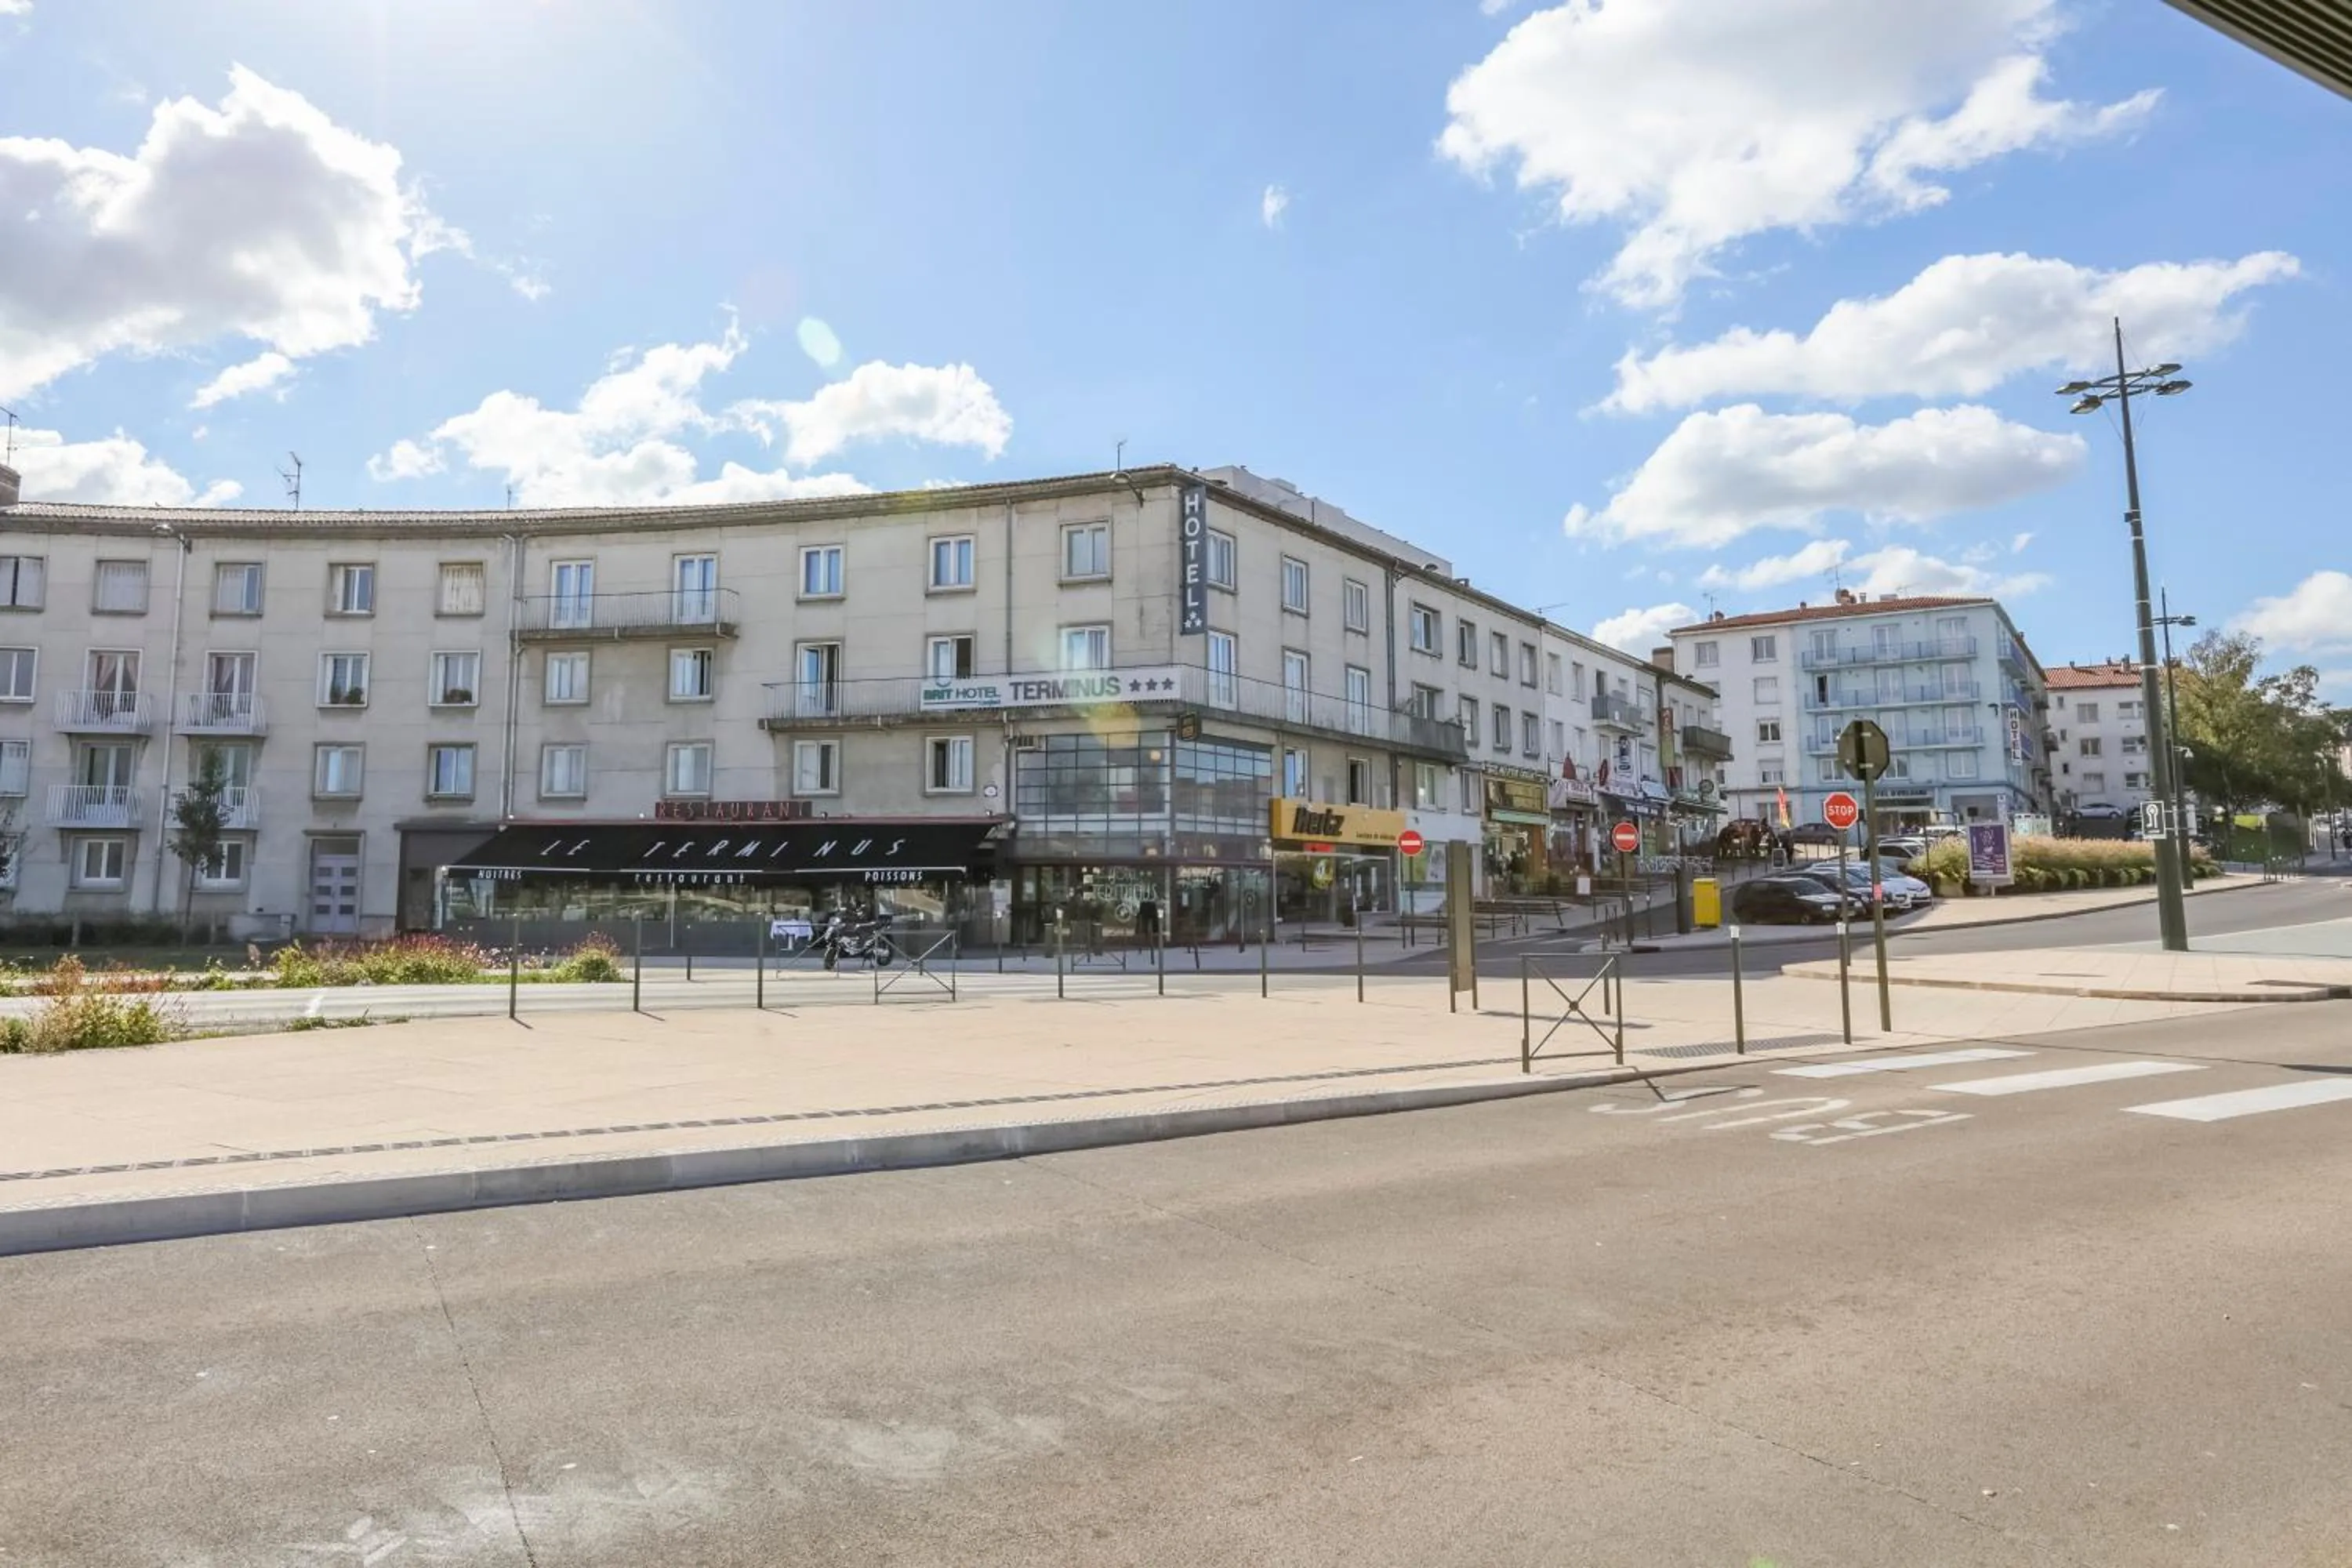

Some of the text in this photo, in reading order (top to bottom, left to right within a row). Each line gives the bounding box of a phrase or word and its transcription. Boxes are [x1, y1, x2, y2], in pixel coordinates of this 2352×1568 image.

[1185, 493, 1200, 607] HOTEL
[924, 686, 1001, 699] BRIT HOTEL
[1009, 677, 1120, 701] TERMINUS
[2009, 710, 2020, 760] HOTEL
[659, 802, 803, 817] RESTAURANT
[1828, 804, 1854, 816] STOP
[1292, 807, 1345, 837] Hertz
[539, 839, 906, 858] LE TERMINUS
[634, 873, 744, 884] restaurant
[865, 871, 923, 882] POISSONS
